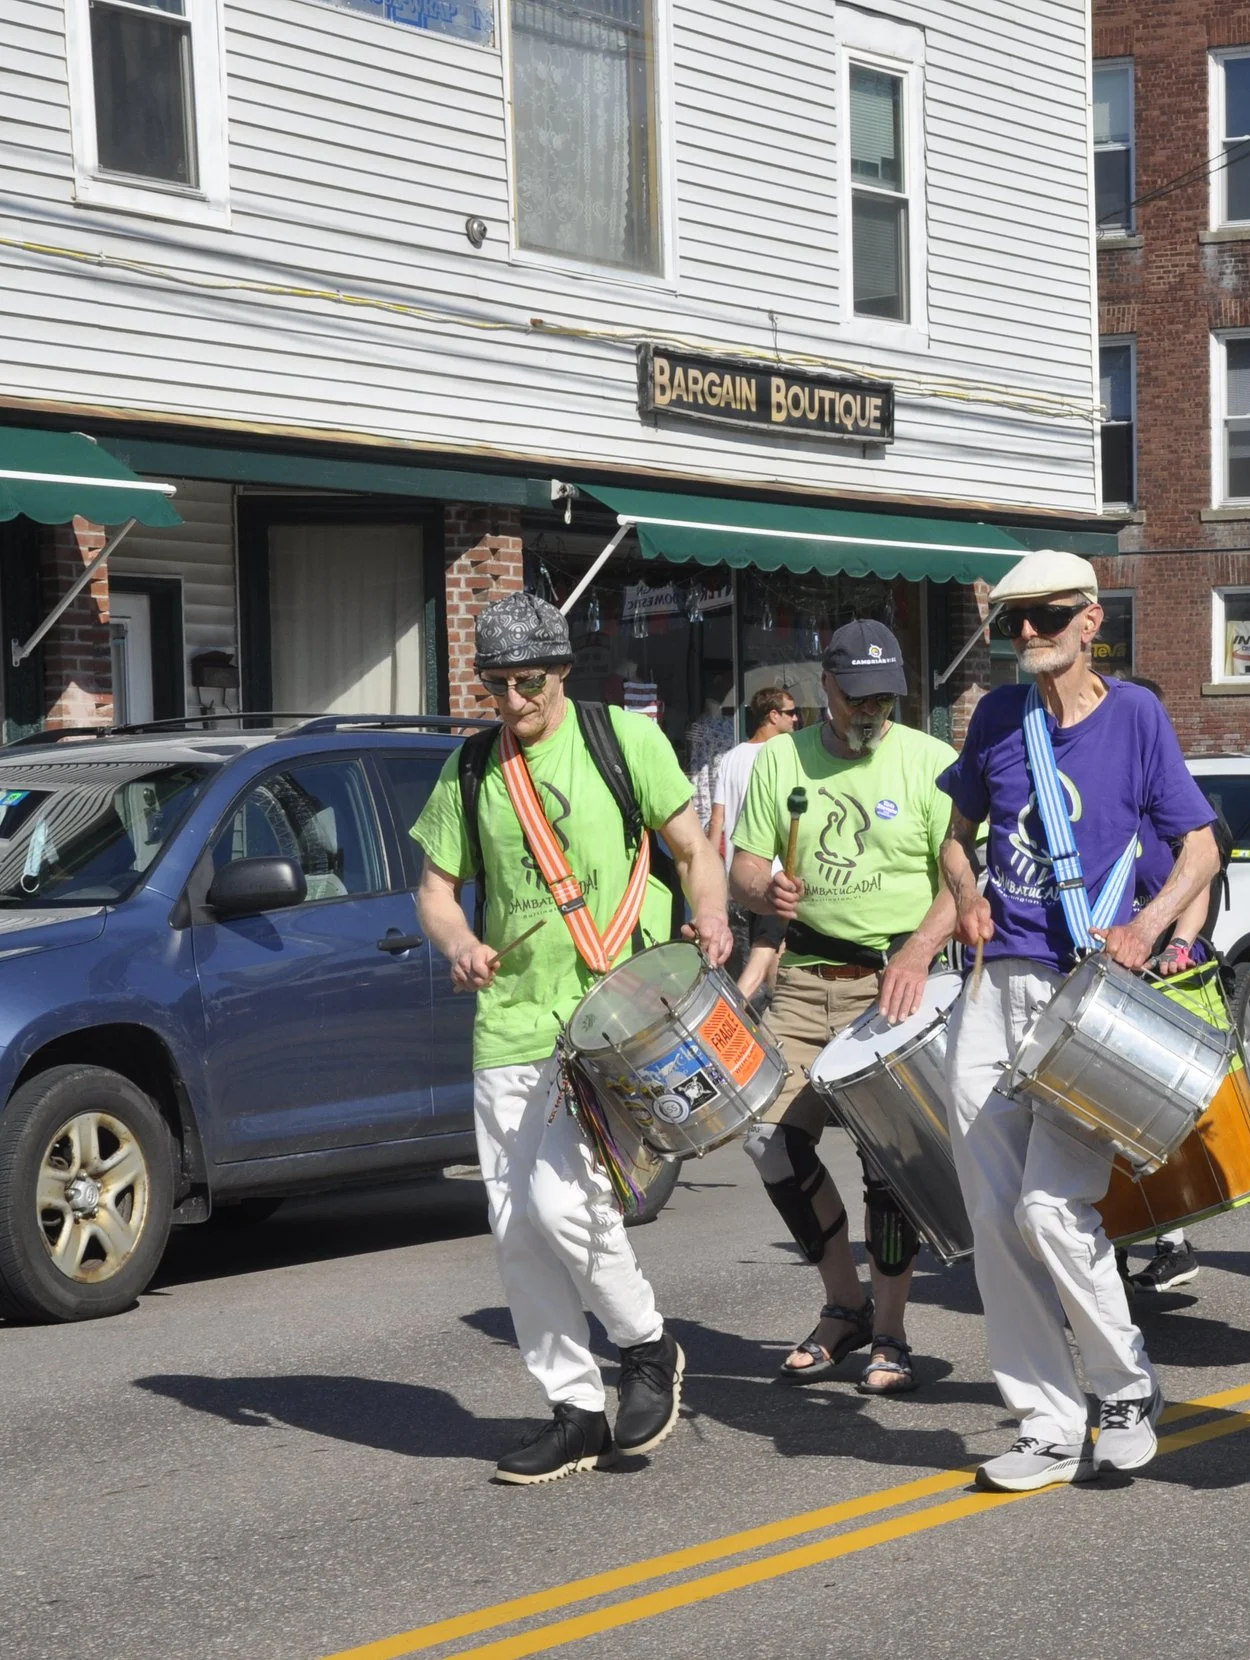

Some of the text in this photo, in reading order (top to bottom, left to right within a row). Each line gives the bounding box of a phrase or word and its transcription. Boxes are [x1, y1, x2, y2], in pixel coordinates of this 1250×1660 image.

[653, 357, 883, 431] BARGAIN BOUTIQUE
[802, 873, 882, 897] AMBATUCADA!
[711, 1013, 739, 1053] FRAGILE
